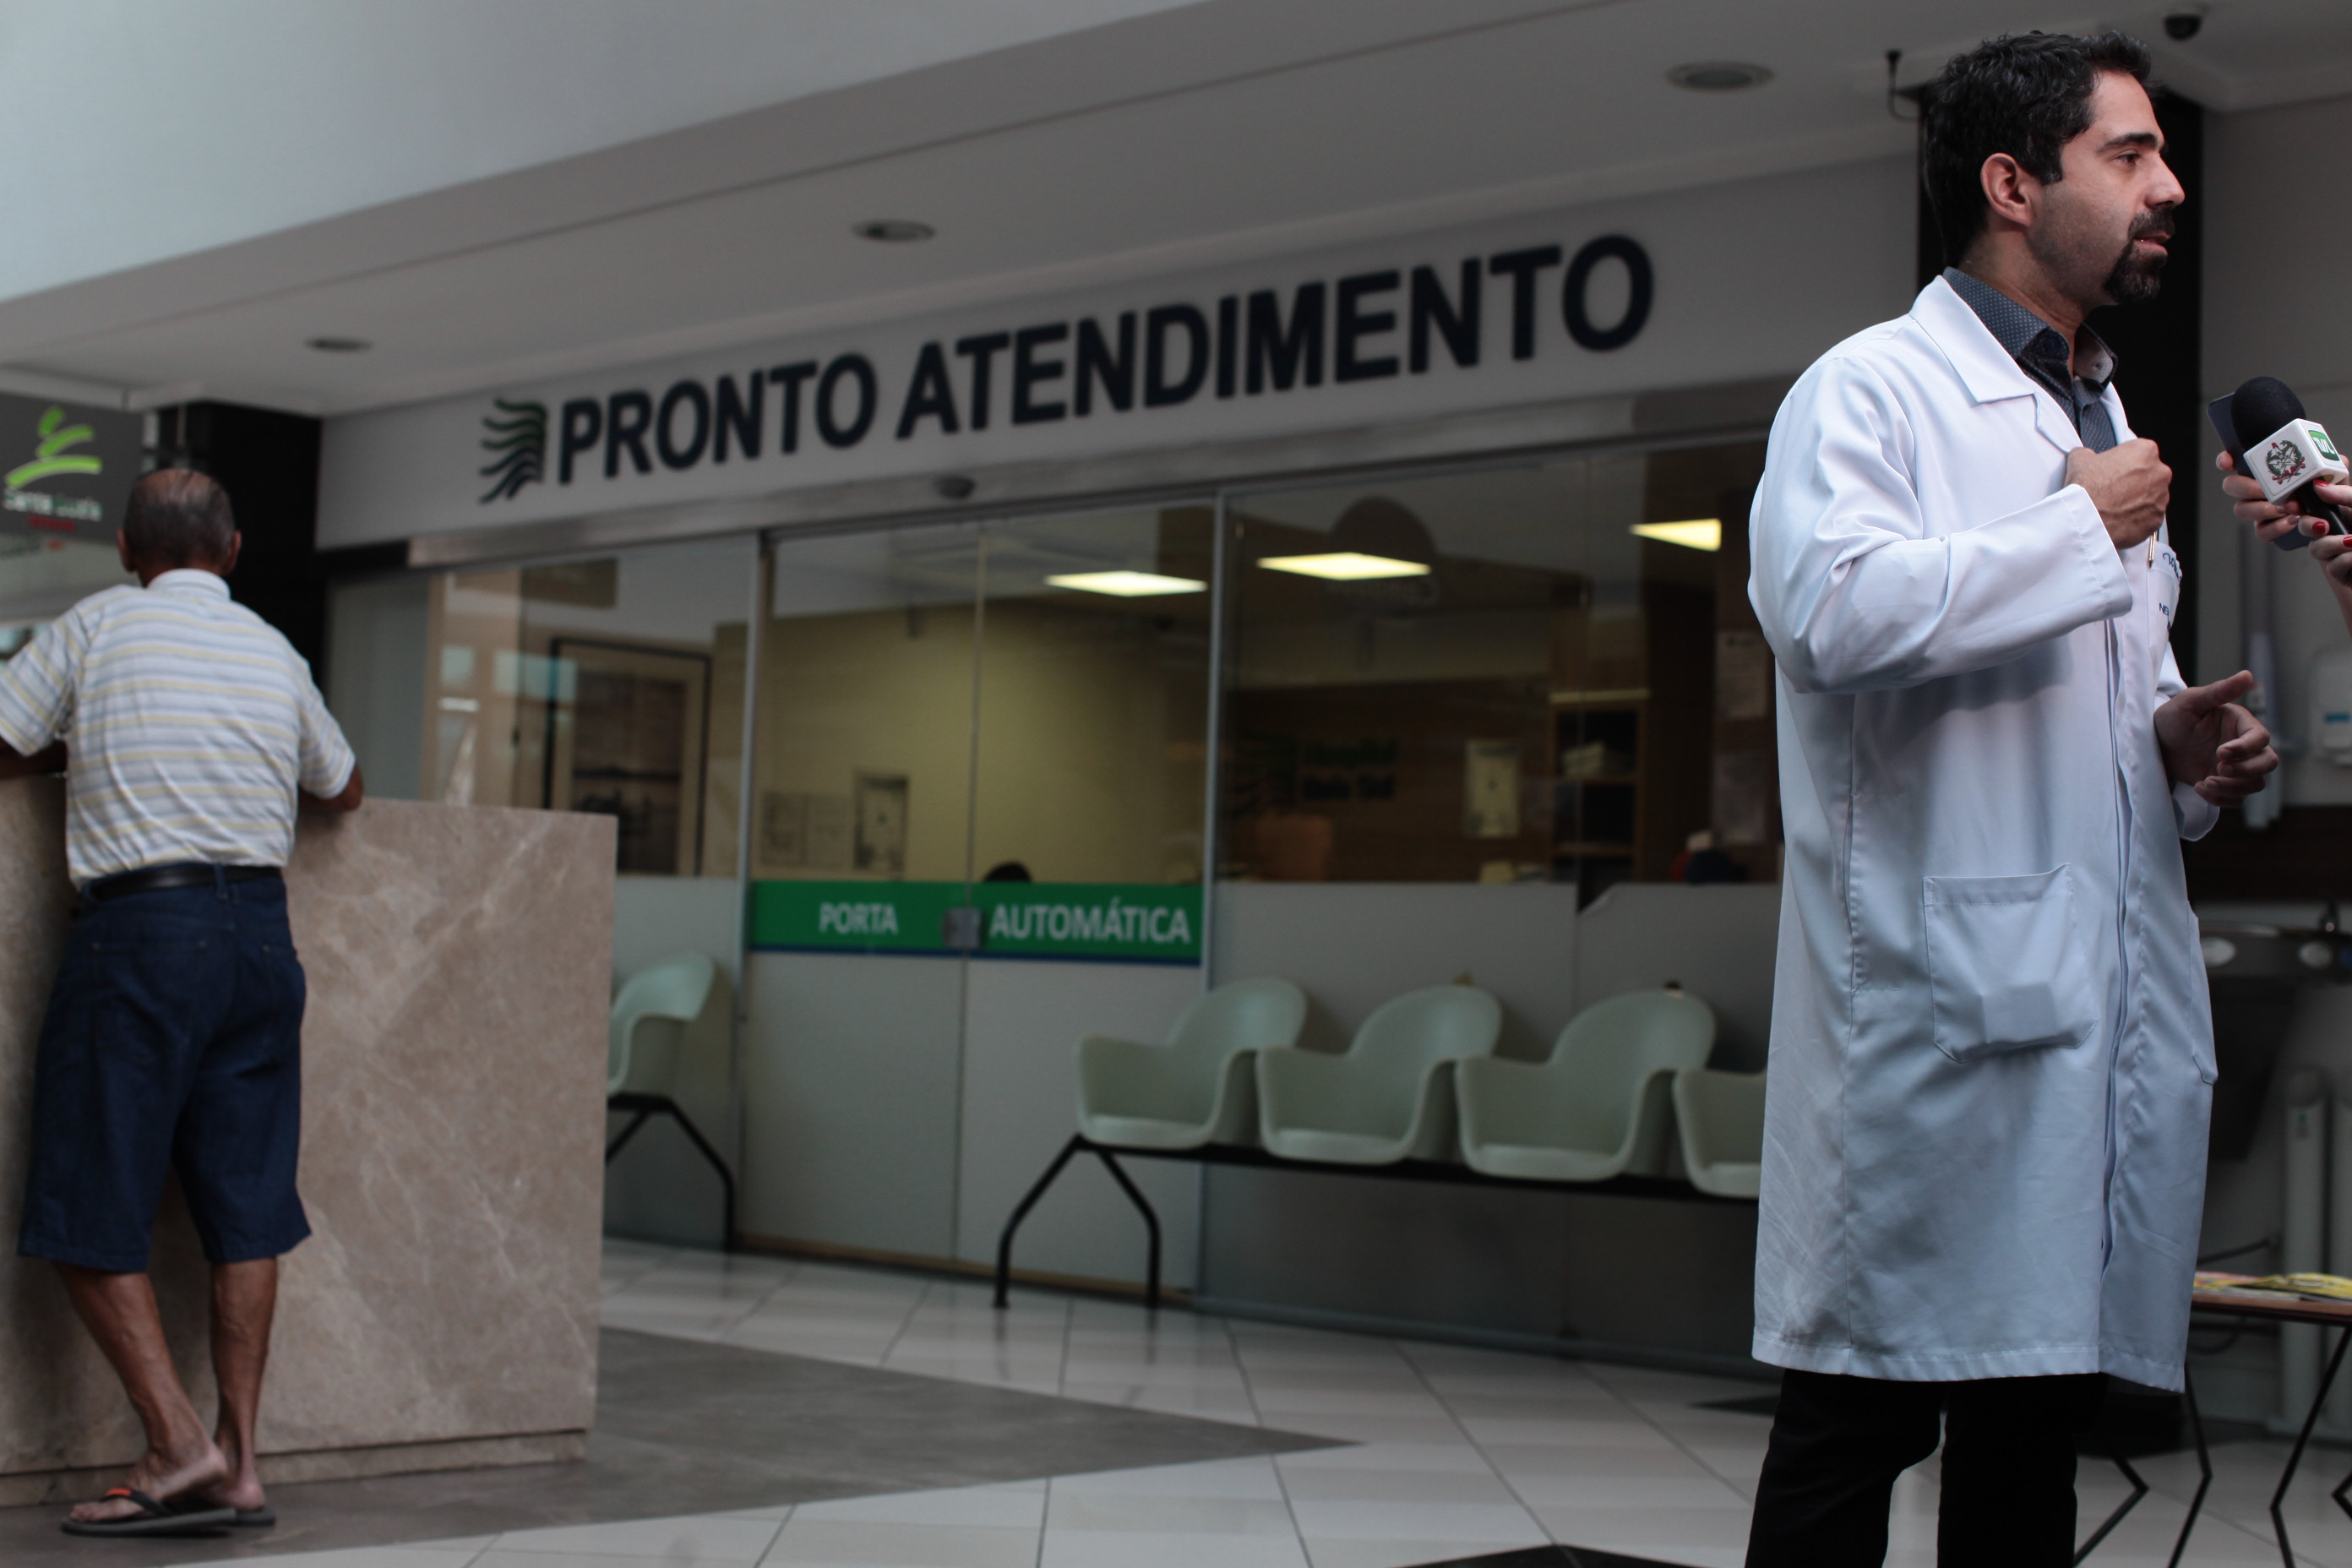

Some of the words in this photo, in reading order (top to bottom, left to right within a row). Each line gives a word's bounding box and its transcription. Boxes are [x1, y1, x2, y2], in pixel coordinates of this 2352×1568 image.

[558, 353, 878, 485] PRONTO
[896, 233, 1656, 439] ATENDIMENTO
[819, 901, 899, 934] PORTA
[989, 896, 1190, 944] AUTOMÁTICA
